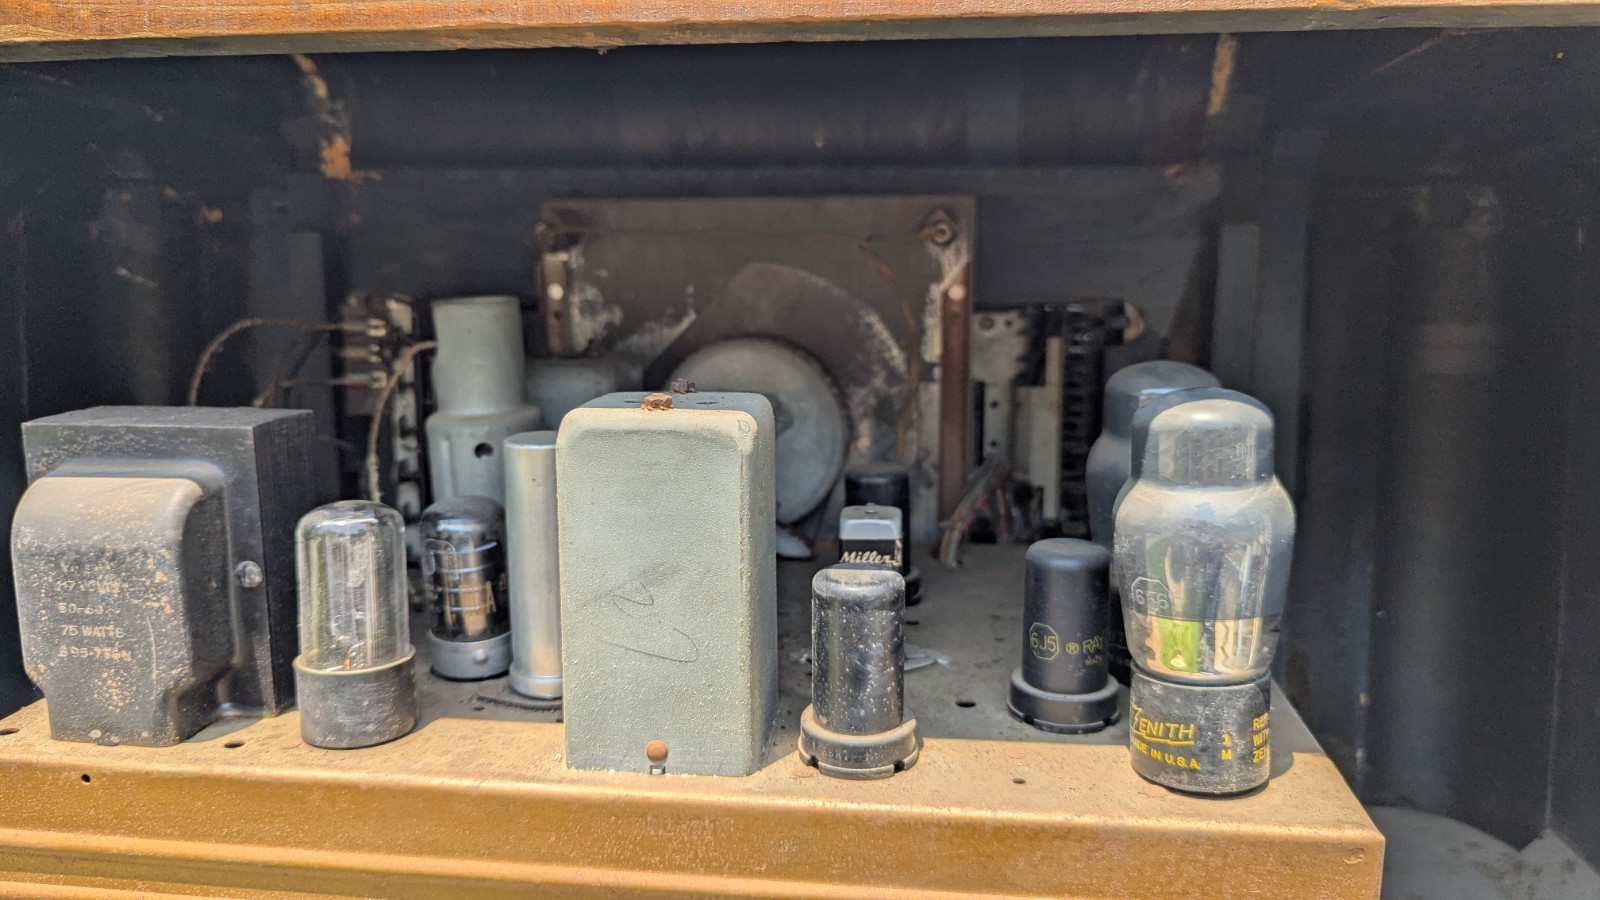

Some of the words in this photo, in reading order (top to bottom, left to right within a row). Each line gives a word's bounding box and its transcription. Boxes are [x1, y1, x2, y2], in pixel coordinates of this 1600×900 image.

[839, 550, 898, 564] Miller
[60, 625, 78, 636] 75
[1031, 632, 1057, 652] 6J5
[1132, 703, 1195, 741] ZENITH
[1151, 747, 1162, 761] IN
[1221, 749, 1232, 762] M
